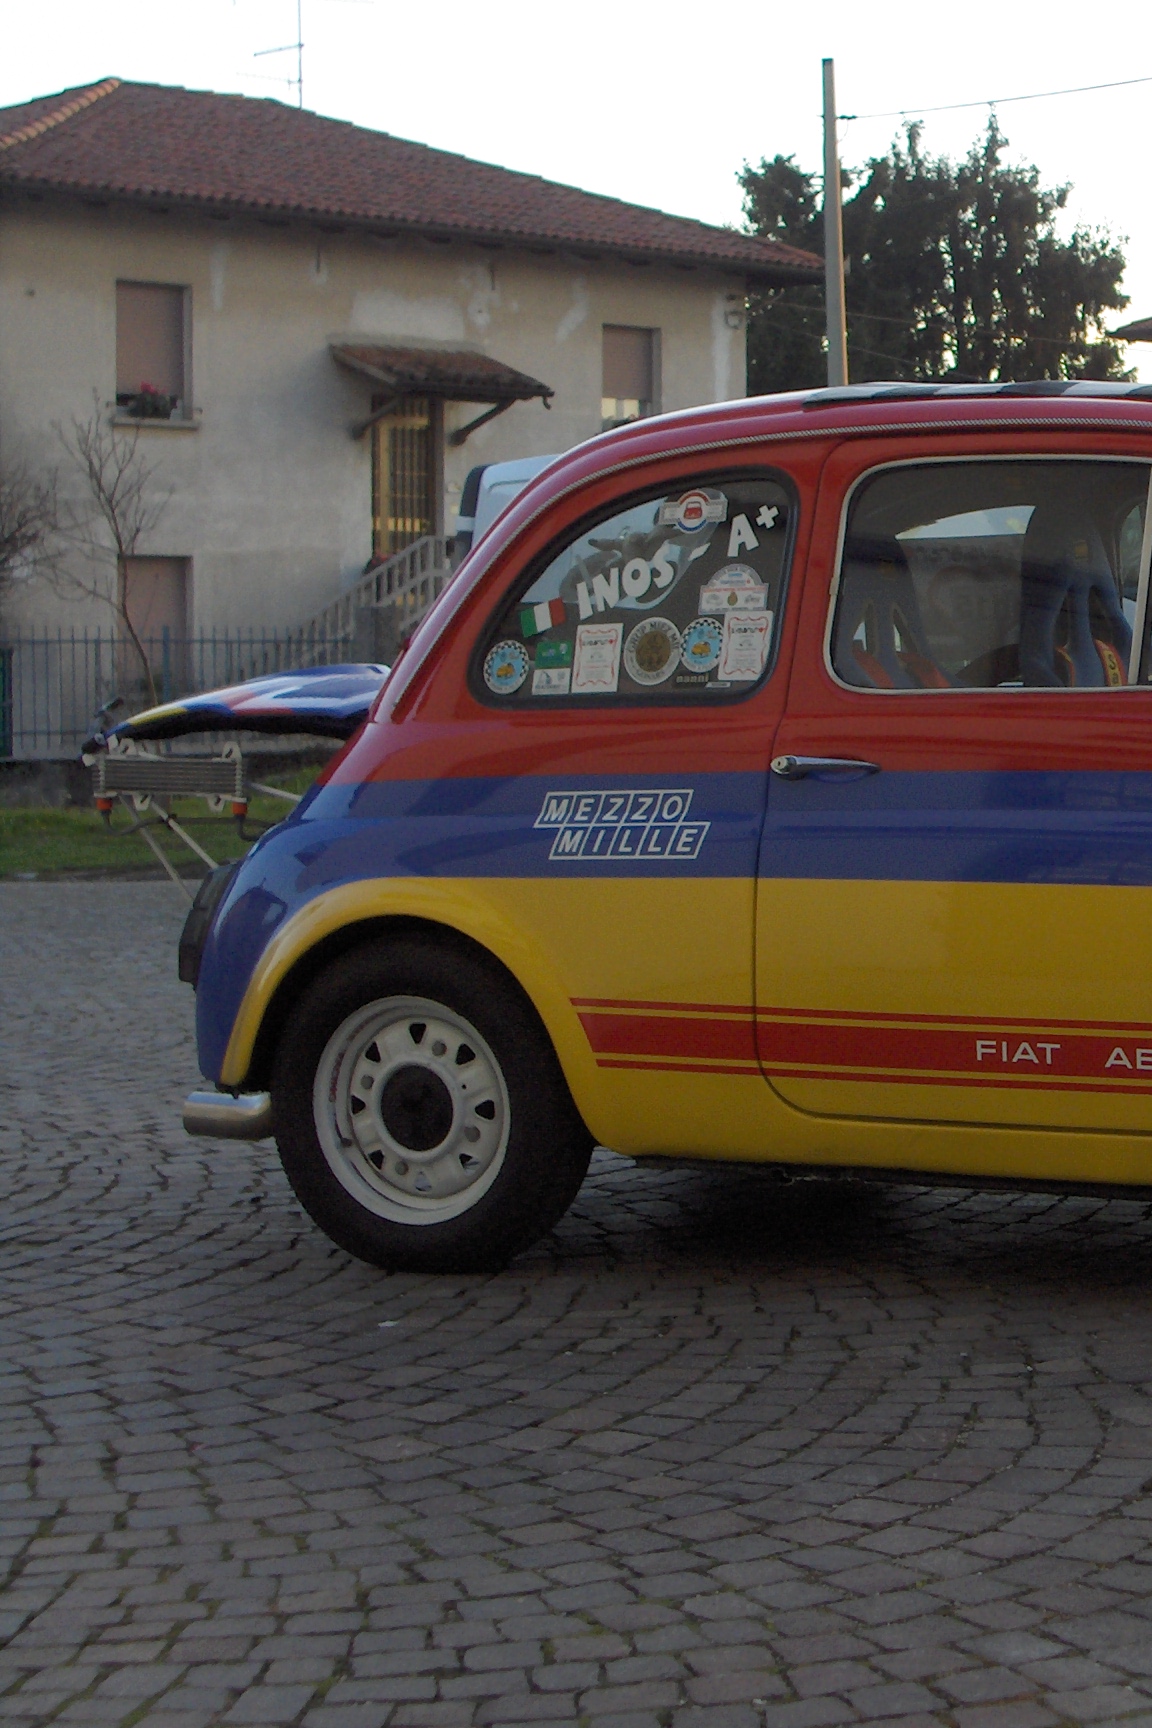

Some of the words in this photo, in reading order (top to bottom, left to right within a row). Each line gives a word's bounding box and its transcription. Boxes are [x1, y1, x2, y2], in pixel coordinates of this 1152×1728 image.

[576, 539, 676, 620] INOS
[544, 795, 683, 822] MEZZO
[557, 829, 698, 853] MILLE
[975, 1040, 1061, 1066] FIAT
